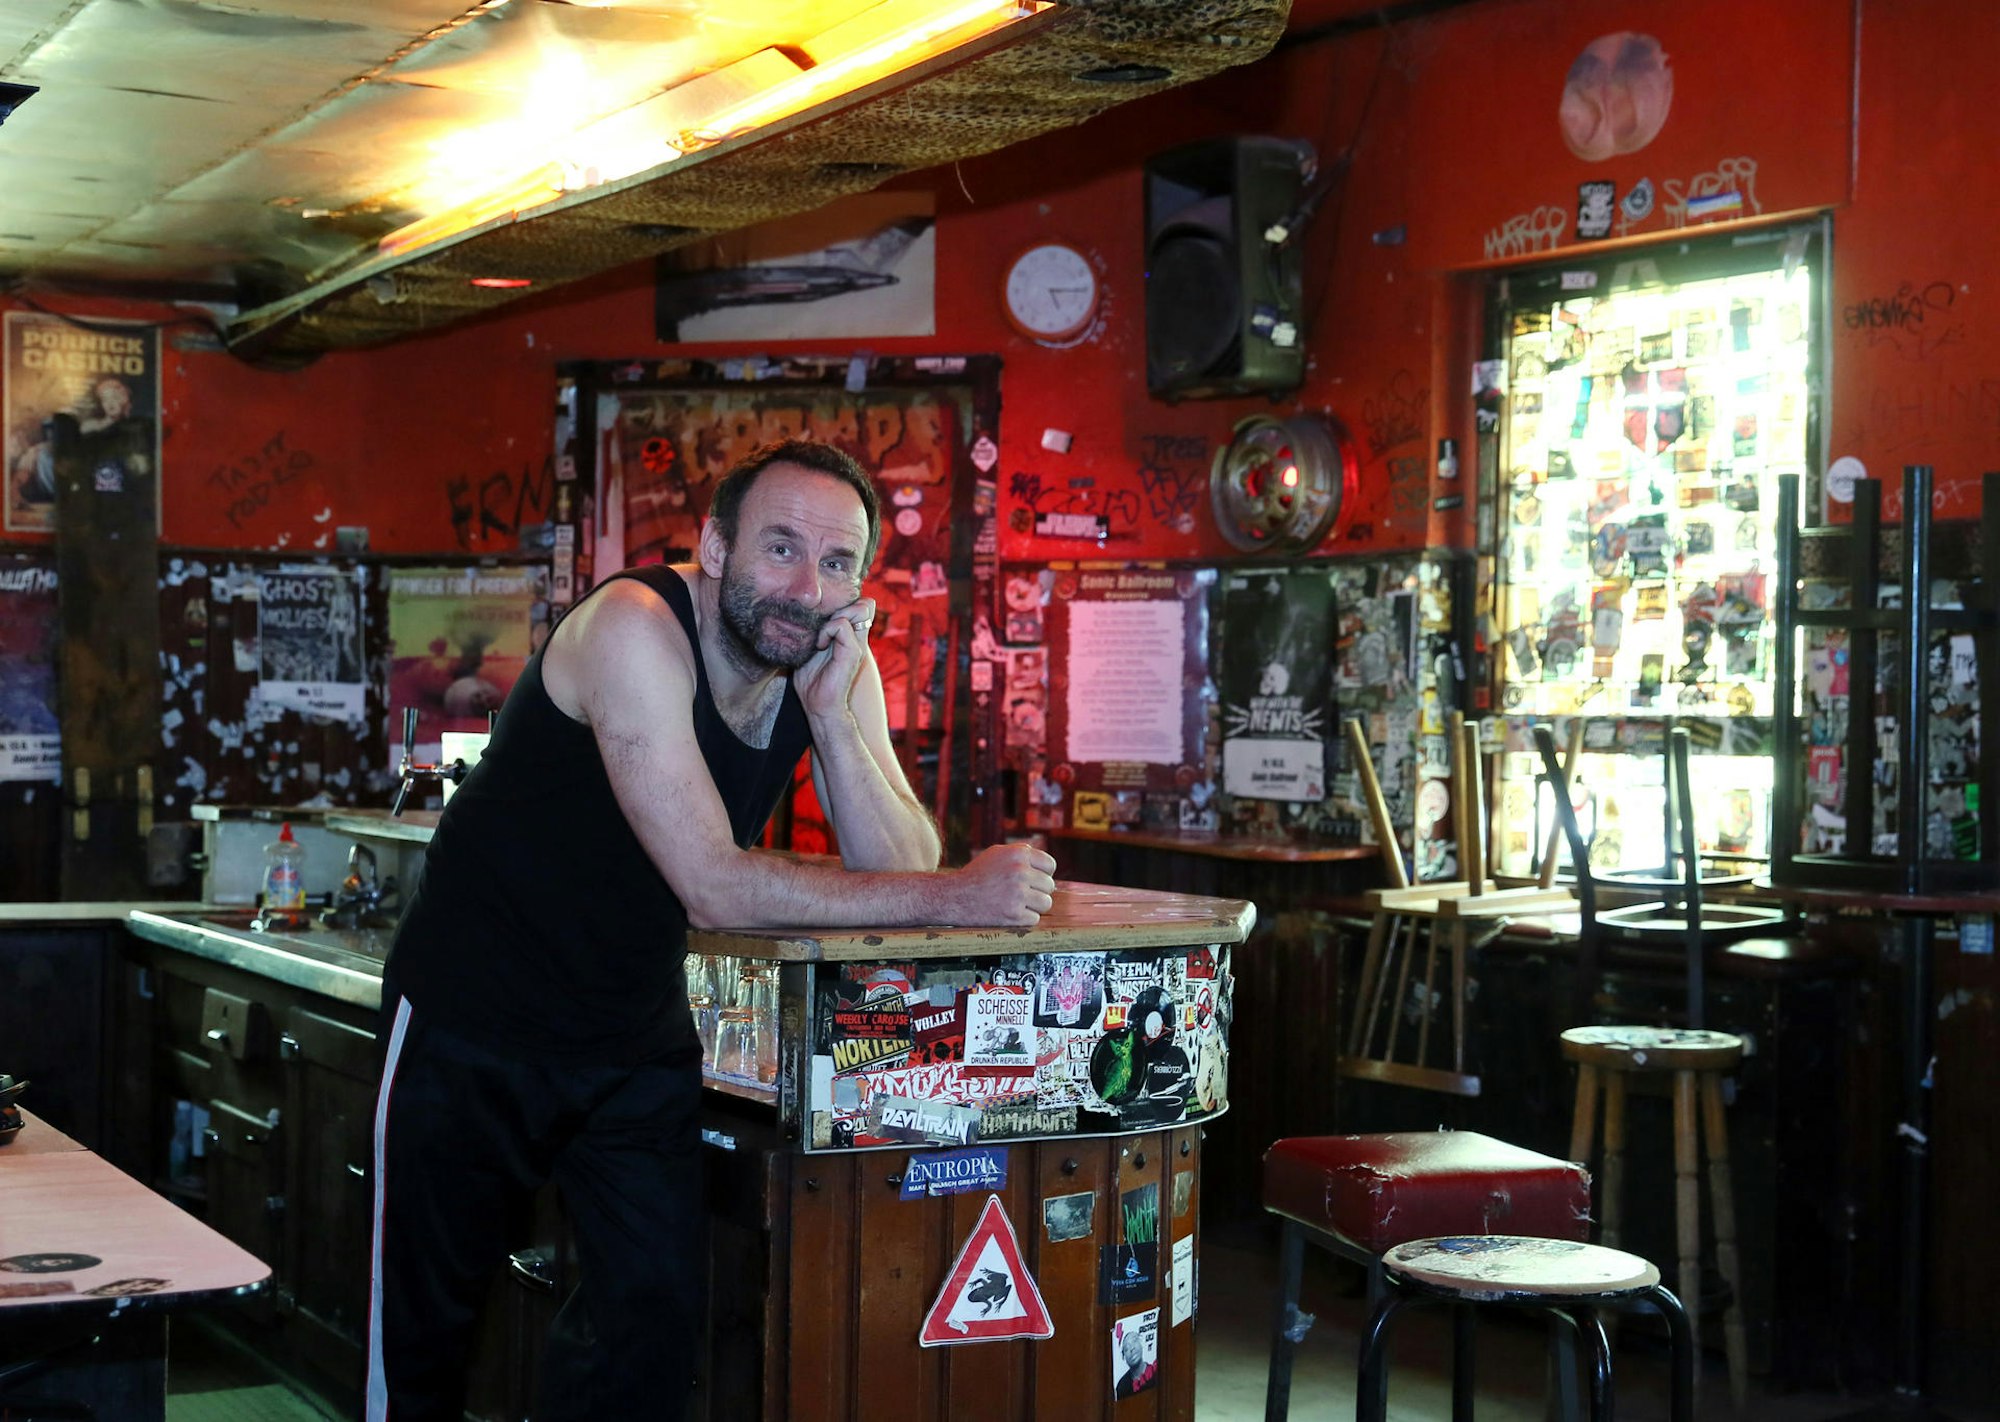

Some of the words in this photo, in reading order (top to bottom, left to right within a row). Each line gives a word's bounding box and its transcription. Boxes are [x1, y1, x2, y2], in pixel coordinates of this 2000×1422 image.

[22, 348, 145, 376] CASINO
[262, 578, 334, 602] GHOST
[262, 607, 328, 629] WOLVES
[977, 998, 1029, 1015] SCHEISSE
[834, 1013, 868, 1025] WEEKLY
[914, 1009, 957, 1032] VOLLEY
[996, 1015, 1025, 1026] MINNELLI
[971, 1056, 999, 1065] DRUNKEN
[1000, 1056, 1029, 1065] REPUBLIC
[881, 1102, 970, 1145] DEVILTRAIN
[910, 1156, 998, 1183] ENTROPIA
[908, 1183, 927, 1192] MAKE
[958, 1178, 979, 1187] GREAT
